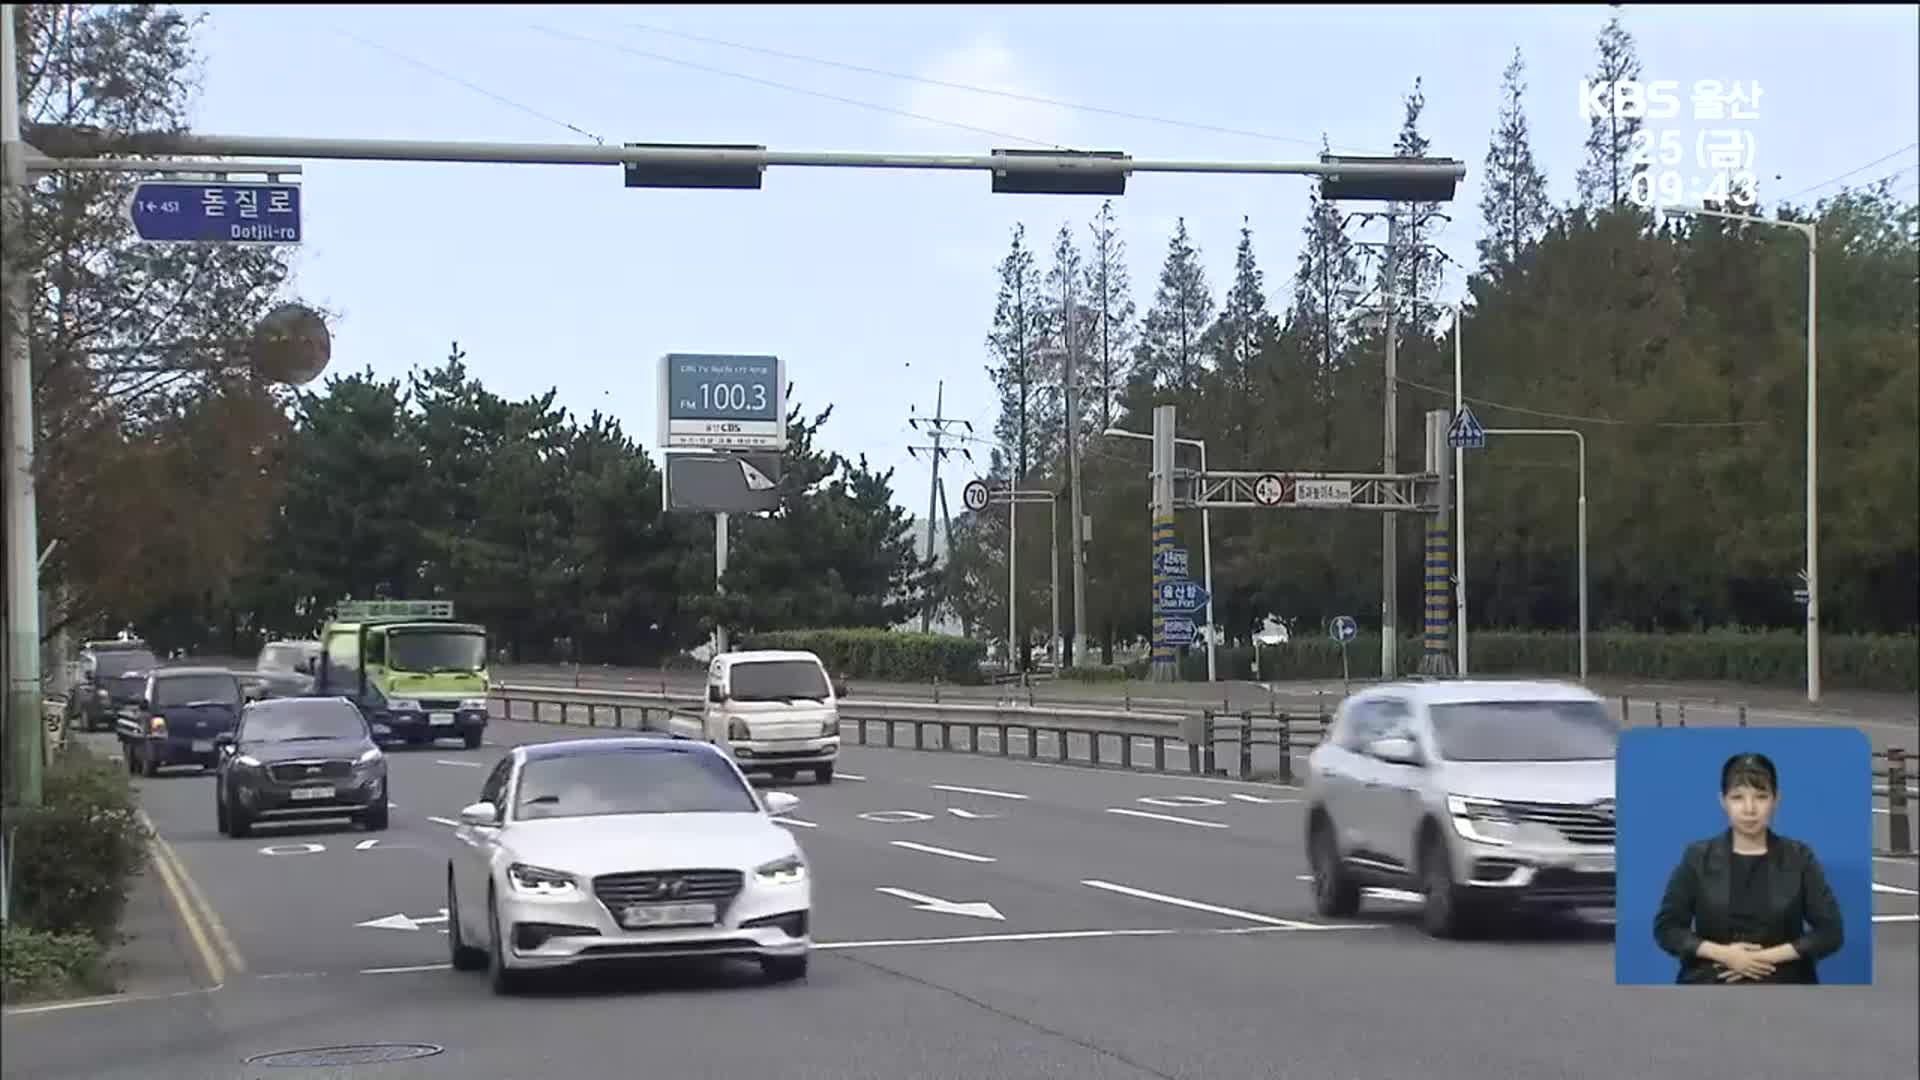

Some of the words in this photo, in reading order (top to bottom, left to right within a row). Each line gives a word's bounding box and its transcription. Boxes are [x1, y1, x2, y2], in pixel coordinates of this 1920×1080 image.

[160, 201, 180, 213] 451
[231, 224, 296, 241] Dotjil-ro
[680, 400, 697, 410] FM
[700, 383, 767, 411] 100.3
[970, 489, 985, 505] 70
